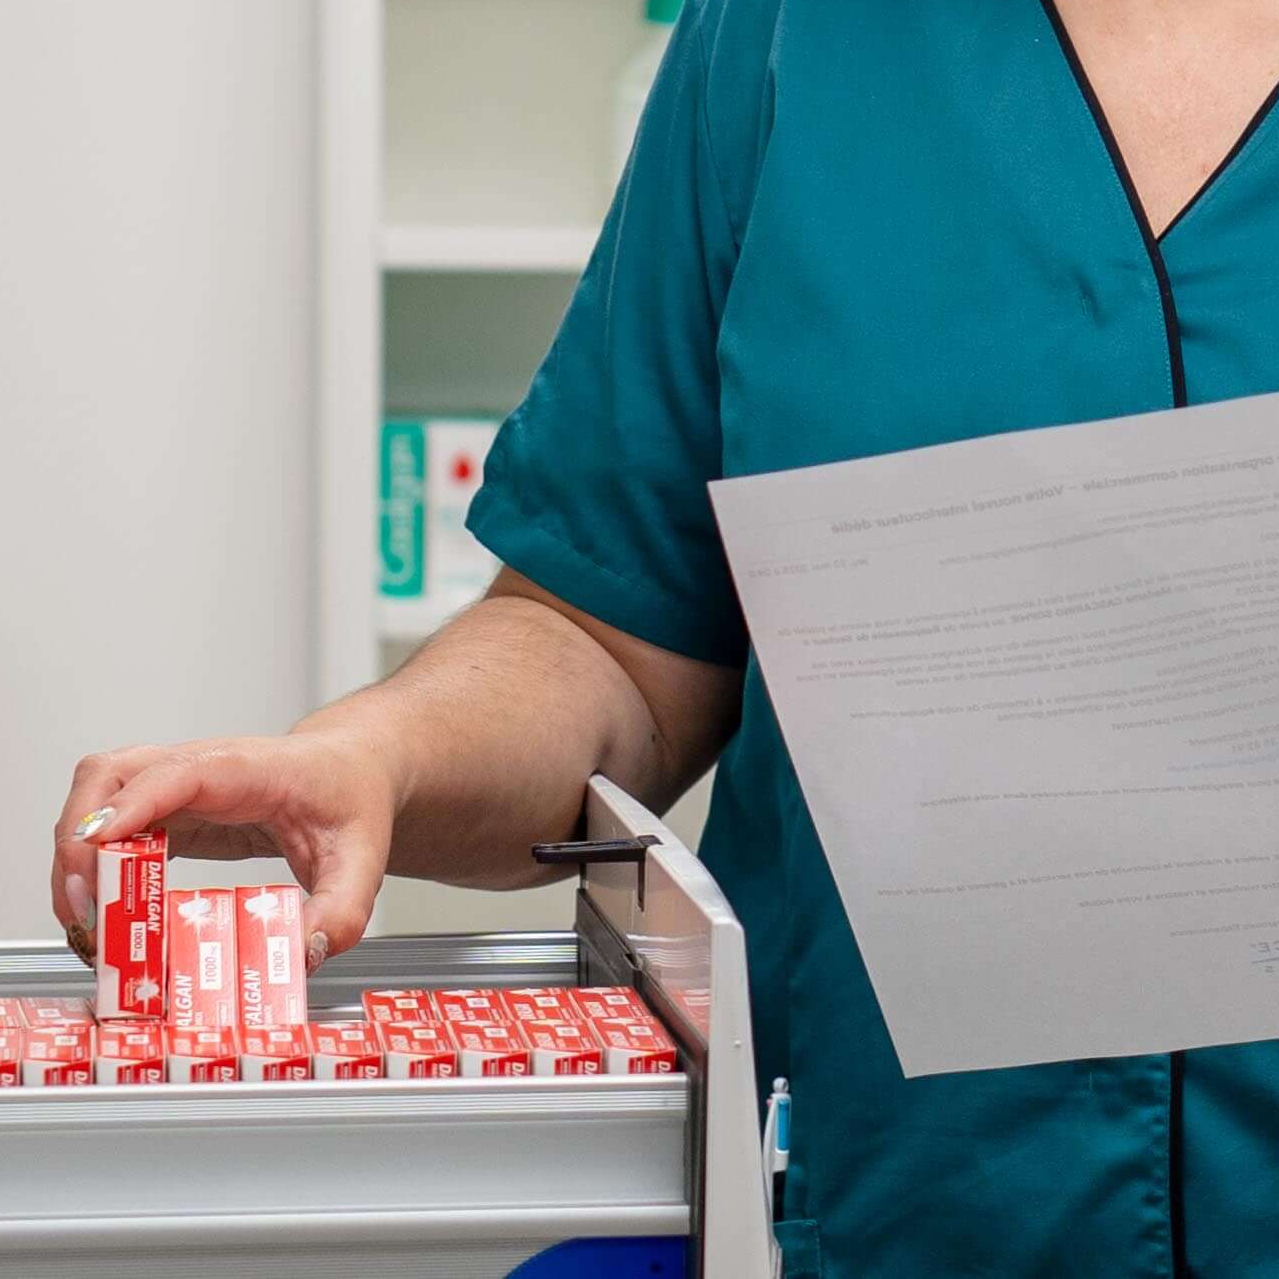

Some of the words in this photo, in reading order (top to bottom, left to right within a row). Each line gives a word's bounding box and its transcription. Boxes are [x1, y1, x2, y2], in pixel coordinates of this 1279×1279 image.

[148, 861, 162, 932] DAFALGAN
[133, 926, 143, 949] 1000
[204, 956, 217, 983] 1000
[273, 951, 285, 977] 1000
[175, 974, 194, 1026] ALGAN
